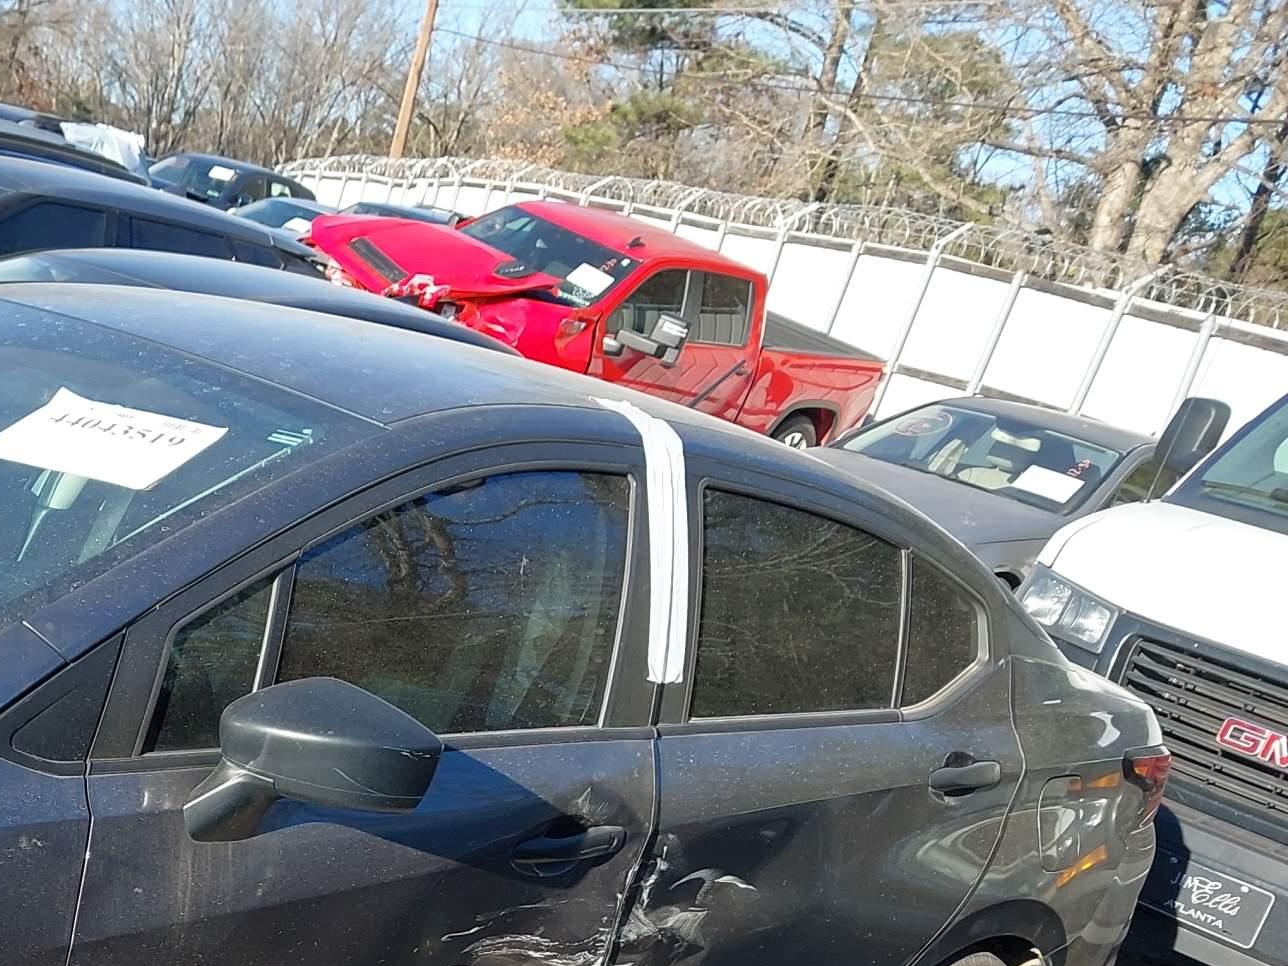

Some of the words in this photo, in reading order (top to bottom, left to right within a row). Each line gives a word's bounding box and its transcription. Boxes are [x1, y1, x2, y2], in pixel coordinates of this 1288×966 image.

[50, 413, 185, 447] 44043519
[1191, 876, 1241, 917] Ellis
[1163, 900, 1223, 929] ATLANTA
